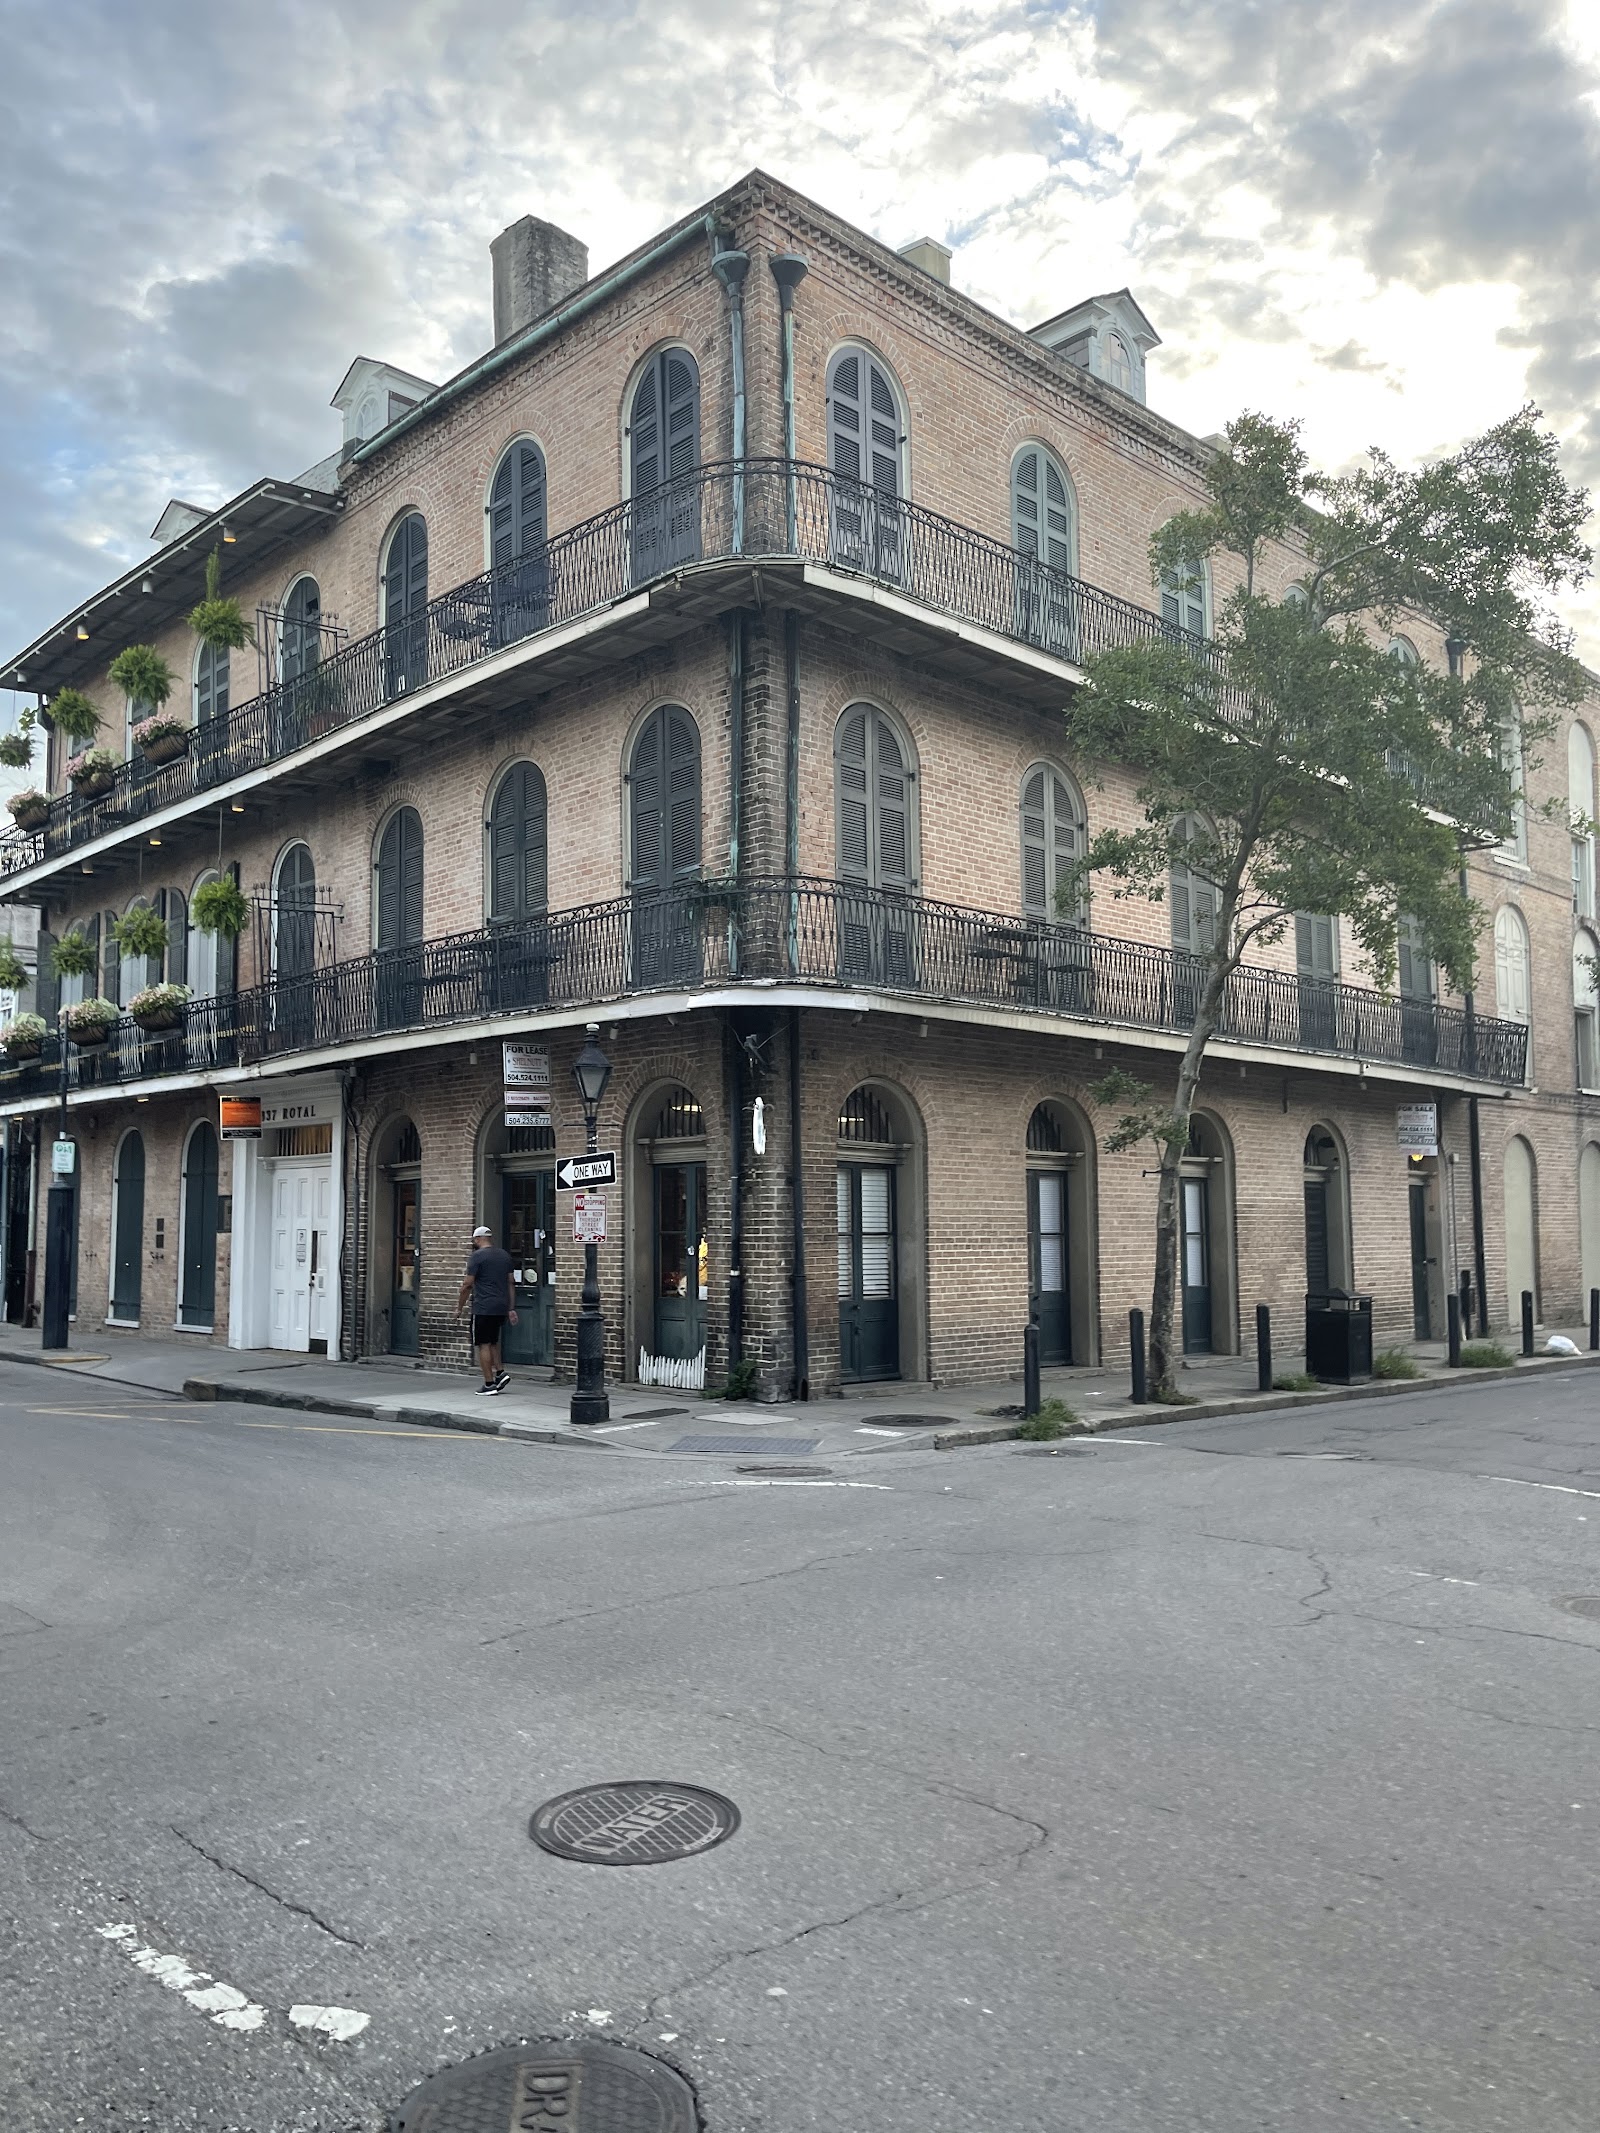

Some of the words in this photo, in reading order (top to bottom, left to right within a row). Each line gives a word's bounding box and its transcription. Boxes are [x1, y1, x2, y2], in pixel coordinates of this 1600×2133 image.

[525, 1046, 548, 1055] LEASE
[283, 1105, 316, 1119] ROYAL
[573, 1165, 589, 1178] ONE
[591, 1162, 609, 1176] WAY
[575, 1198, 584, 1208] NO
[578, 1798, 693, 1849] WATER
[519, 2072, 570, 2133] DR
